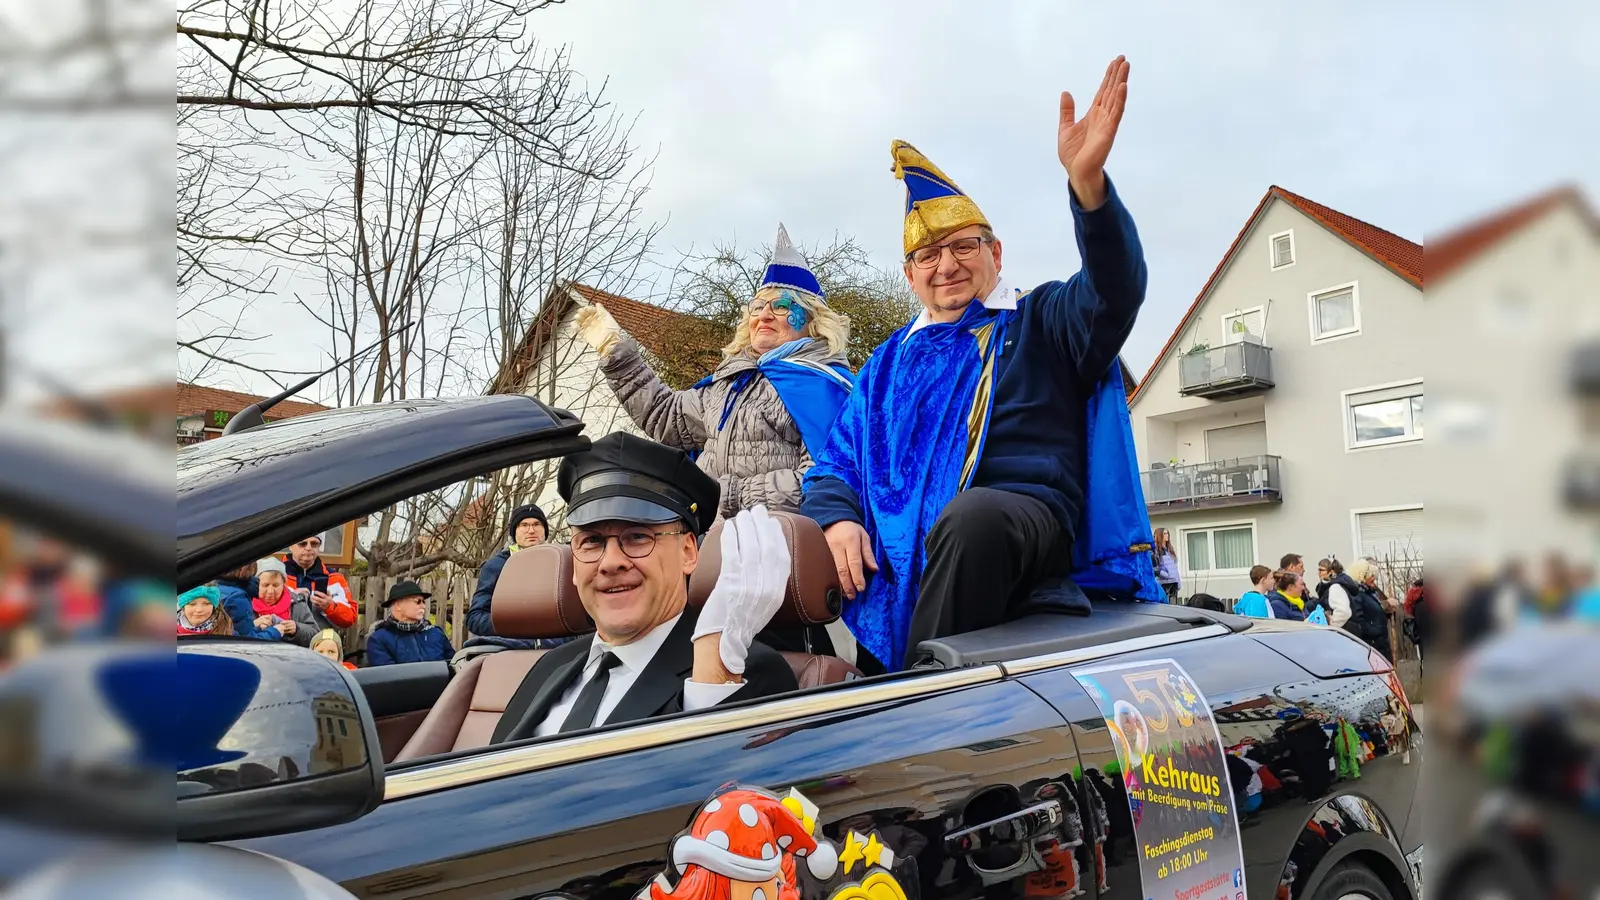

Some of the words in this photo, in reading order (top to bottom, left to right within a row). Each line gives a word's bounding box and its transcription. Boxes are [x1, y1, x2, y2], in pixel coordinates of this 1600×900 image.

[1141, 753, 1220, 797] Kehraus
[1132, 788, 1145, 800] mit
[1147, 788, 1191, 811] Beerdigung
[1193, 801, 1208, 811] vom
[1144, 826, 1214, 860] Faschingsdienstag
[1157, 863, 1168, 879] ab
[1170, 852, 1192, 874] 18:00
[1194, 848, 1208, 865] Uhr
